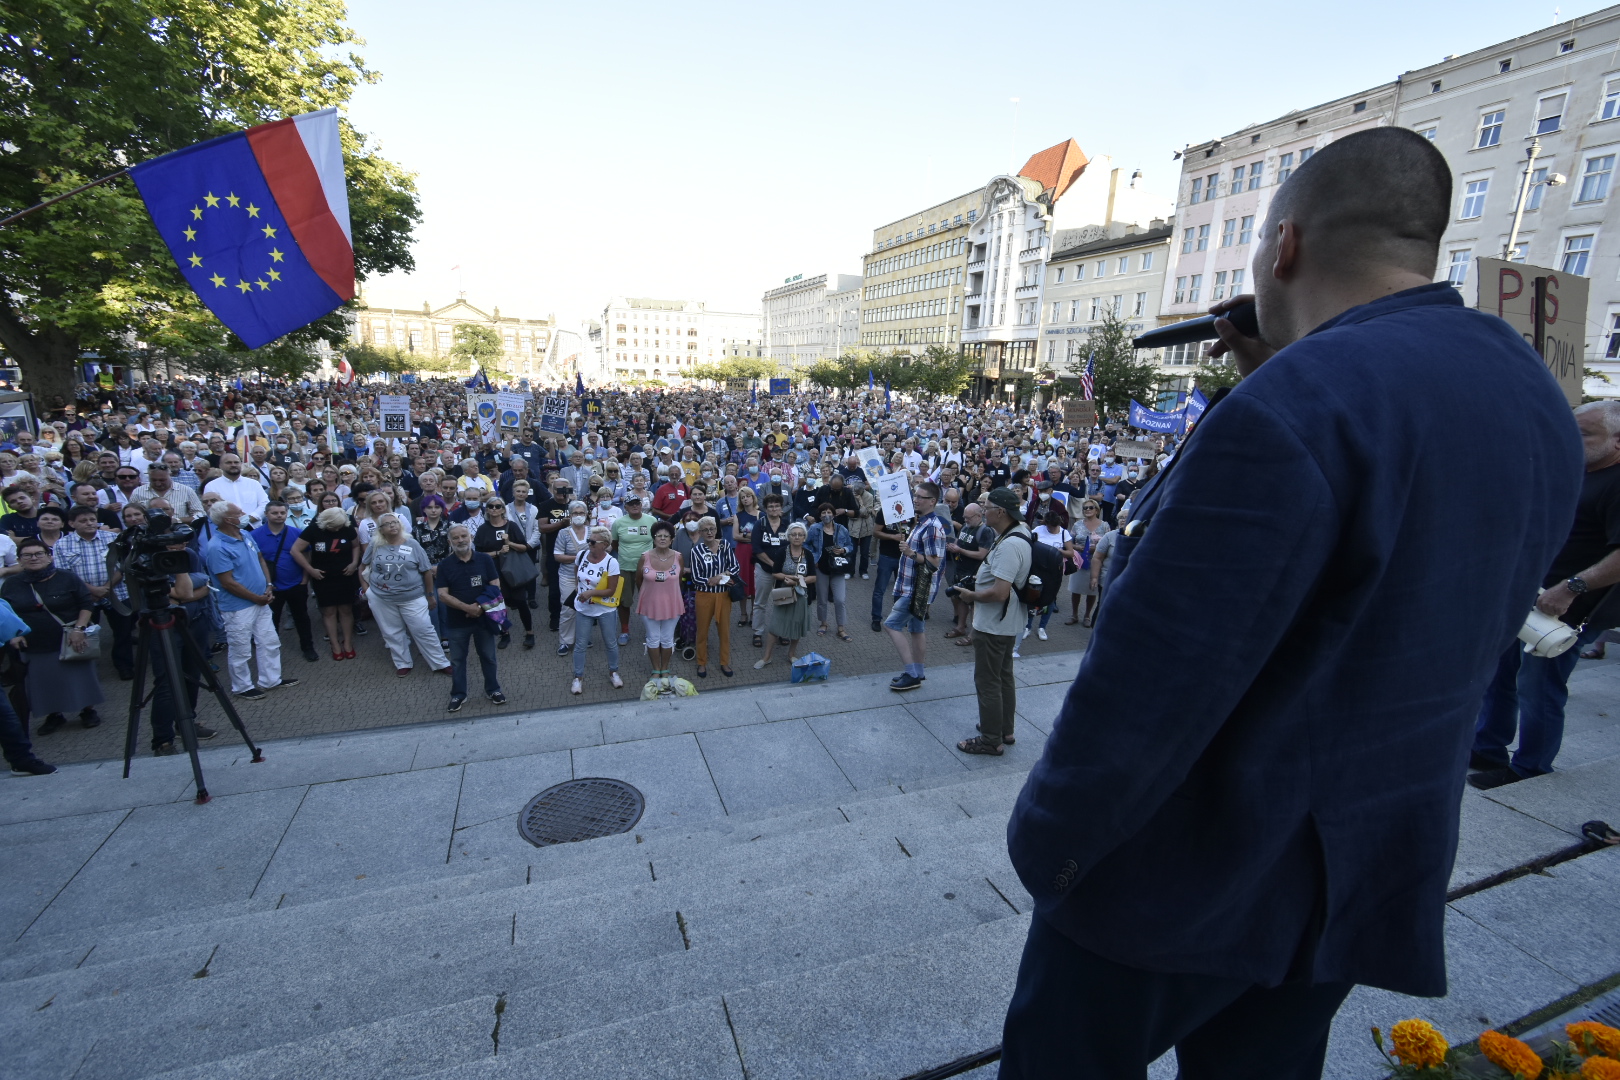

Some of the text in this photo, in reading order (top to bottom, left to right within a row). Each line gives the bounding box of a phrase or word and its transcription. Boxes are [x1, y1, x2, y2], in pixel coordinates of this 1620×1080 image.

[1499, 268, 1559, 325] PiS
[547, 397, 565, 405] TVP
[546, 407, 564, 416] ŁŻE
[1141, 418, 1172, 429] POZNAŃ
[376, 563, 404, 572] STY
